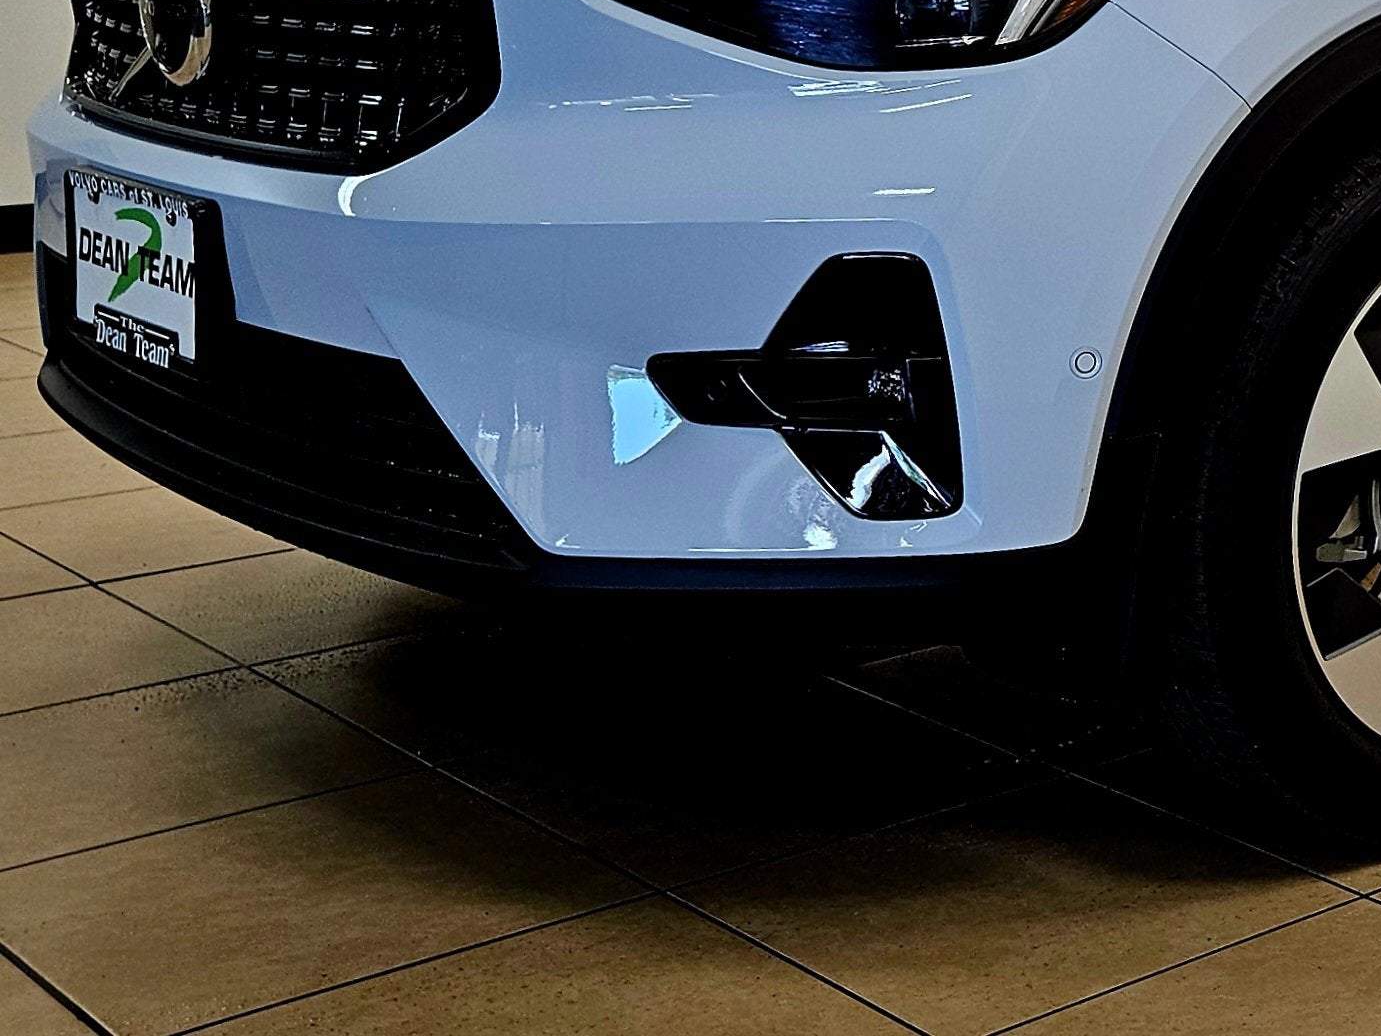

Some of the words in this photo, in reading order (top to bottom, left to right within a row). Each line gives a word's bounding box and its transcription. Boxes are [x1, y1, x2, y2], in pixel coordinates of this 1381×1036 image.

[68, 170, 98, 193] VOLVO
[100, 179, 127, 200] CARS
[140, 189, 157, 209] ST.
[159, 194, 189, 219] LOUIS
[78, 226, 130, 276] DEAN
[137, 245, 195, 299] TEAM
[119, 315, 145, 333] The
